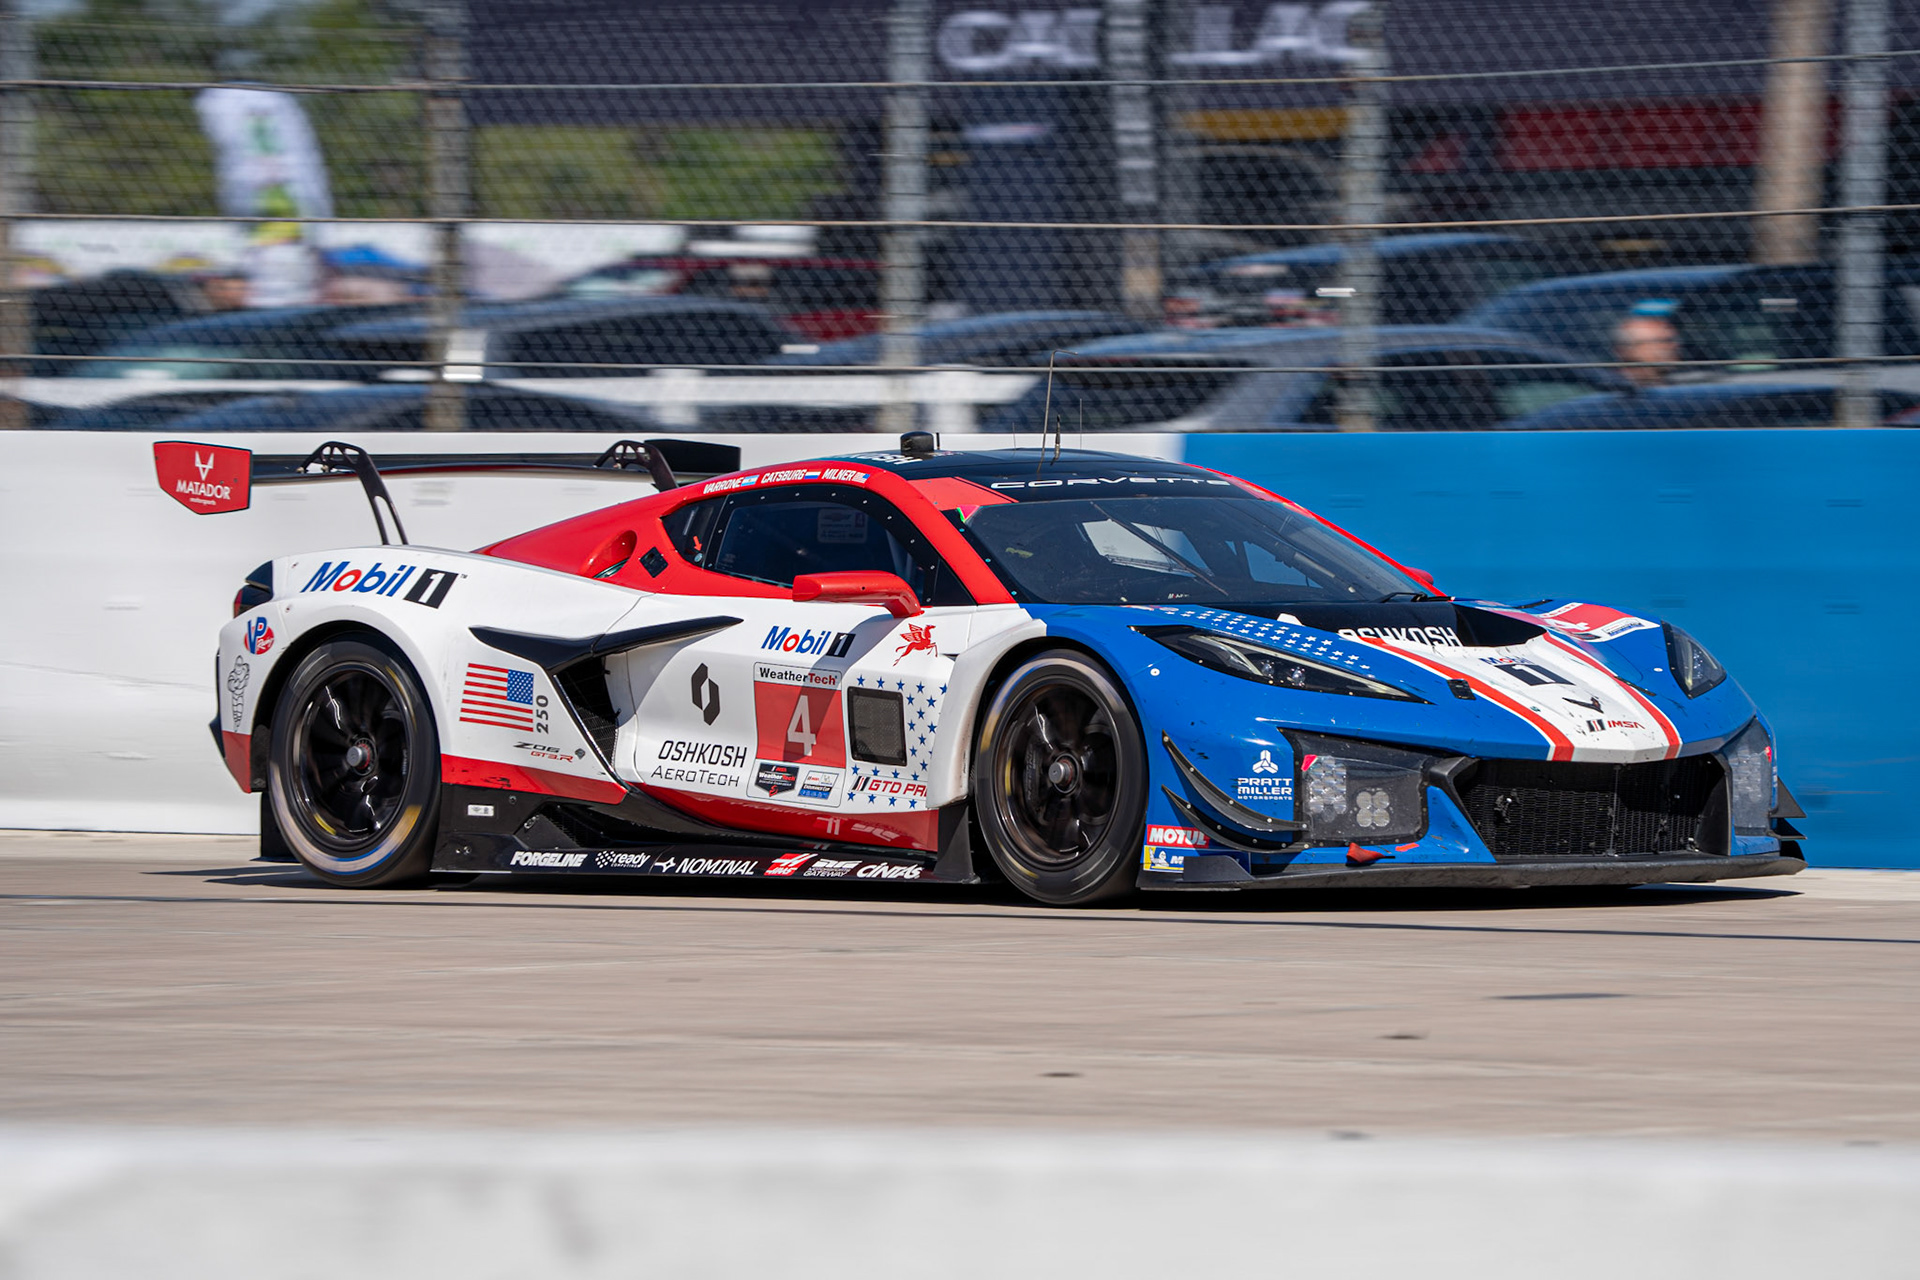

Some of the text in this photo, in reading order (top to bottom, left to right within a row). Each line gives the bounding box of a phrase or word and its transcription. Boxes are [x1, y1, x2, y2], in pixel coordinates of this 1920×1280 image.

[176, 480, 231, 500] MATADOR
[703, 467, 854, 495] VARRONE CATSBURG MILNER
[990, 477, 1231, 489] CORVETTE
[300, 561, 416, 597] Mobil
[247, 616, 268, 655] VP
[761, 626, 832, 655] Mobil
[760, 667, 836, 685] WeatherTech
[536, 695, 549, 734] 250
[787, 695, 817, 757] 4
[1607, 720, 1646, 730] IMSA
[513, 741, 560, 753] Z06
[658, 740, 747, 768] OSHKOSH
[868, 779, 928, 798] GTD PR
[1237, 777, 1292, 786] PRATT
[1237, 786, 1292, 795] MILLER
[1149, 827, 1207, 846] MOTUL
[510, 851, 588, 867] FORGELINE
[612, 852, 651, 868] ready
[675, 858, 758, 875] NOMINAL
[803, 869, 849, 877] GATEWAY
